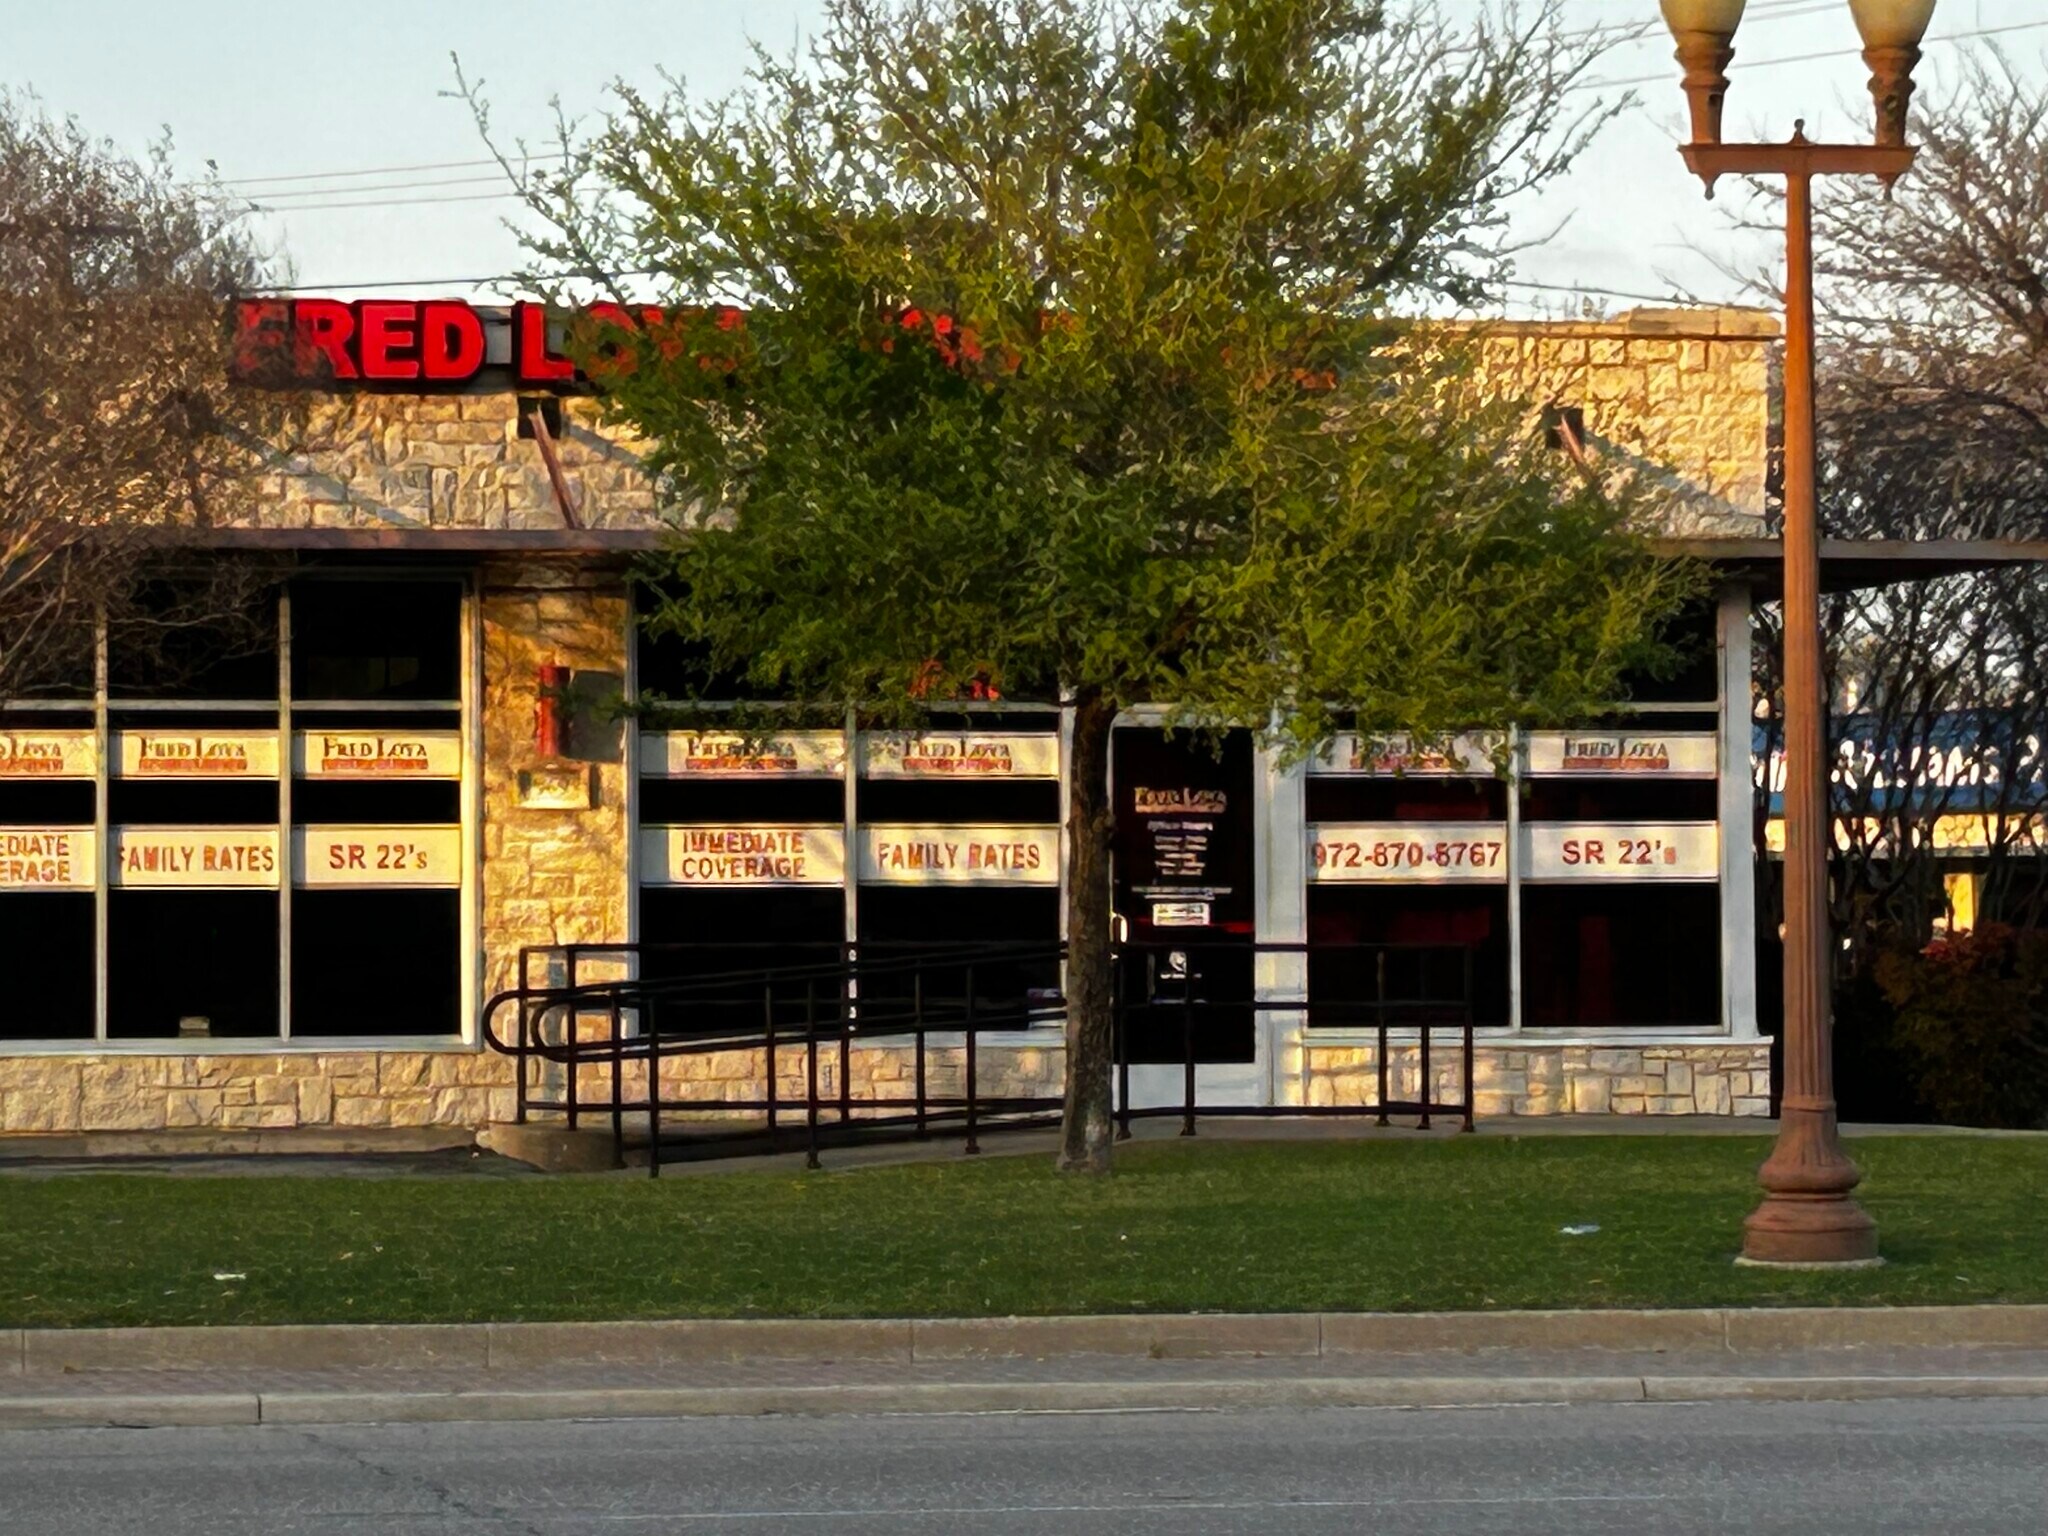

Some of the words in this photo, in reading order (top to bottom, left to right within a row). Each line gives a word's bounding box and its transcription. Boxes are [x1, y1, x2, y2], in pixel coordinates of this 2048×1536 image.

[234, 301, 485, 380] FRED
[683, 831, 805, 853] IMMEDIATE
[1562, 840, 1605, 865] SR
[203, 845, 274, 872] RATES
[329, 844, 366, 869] SR
[376, 844, 427, 869] 22's
[682, 857, 806, 879] COVERAGE
[879, 842, 958, 870] FAMILY
[968, 842, 1041, 870] RATES
